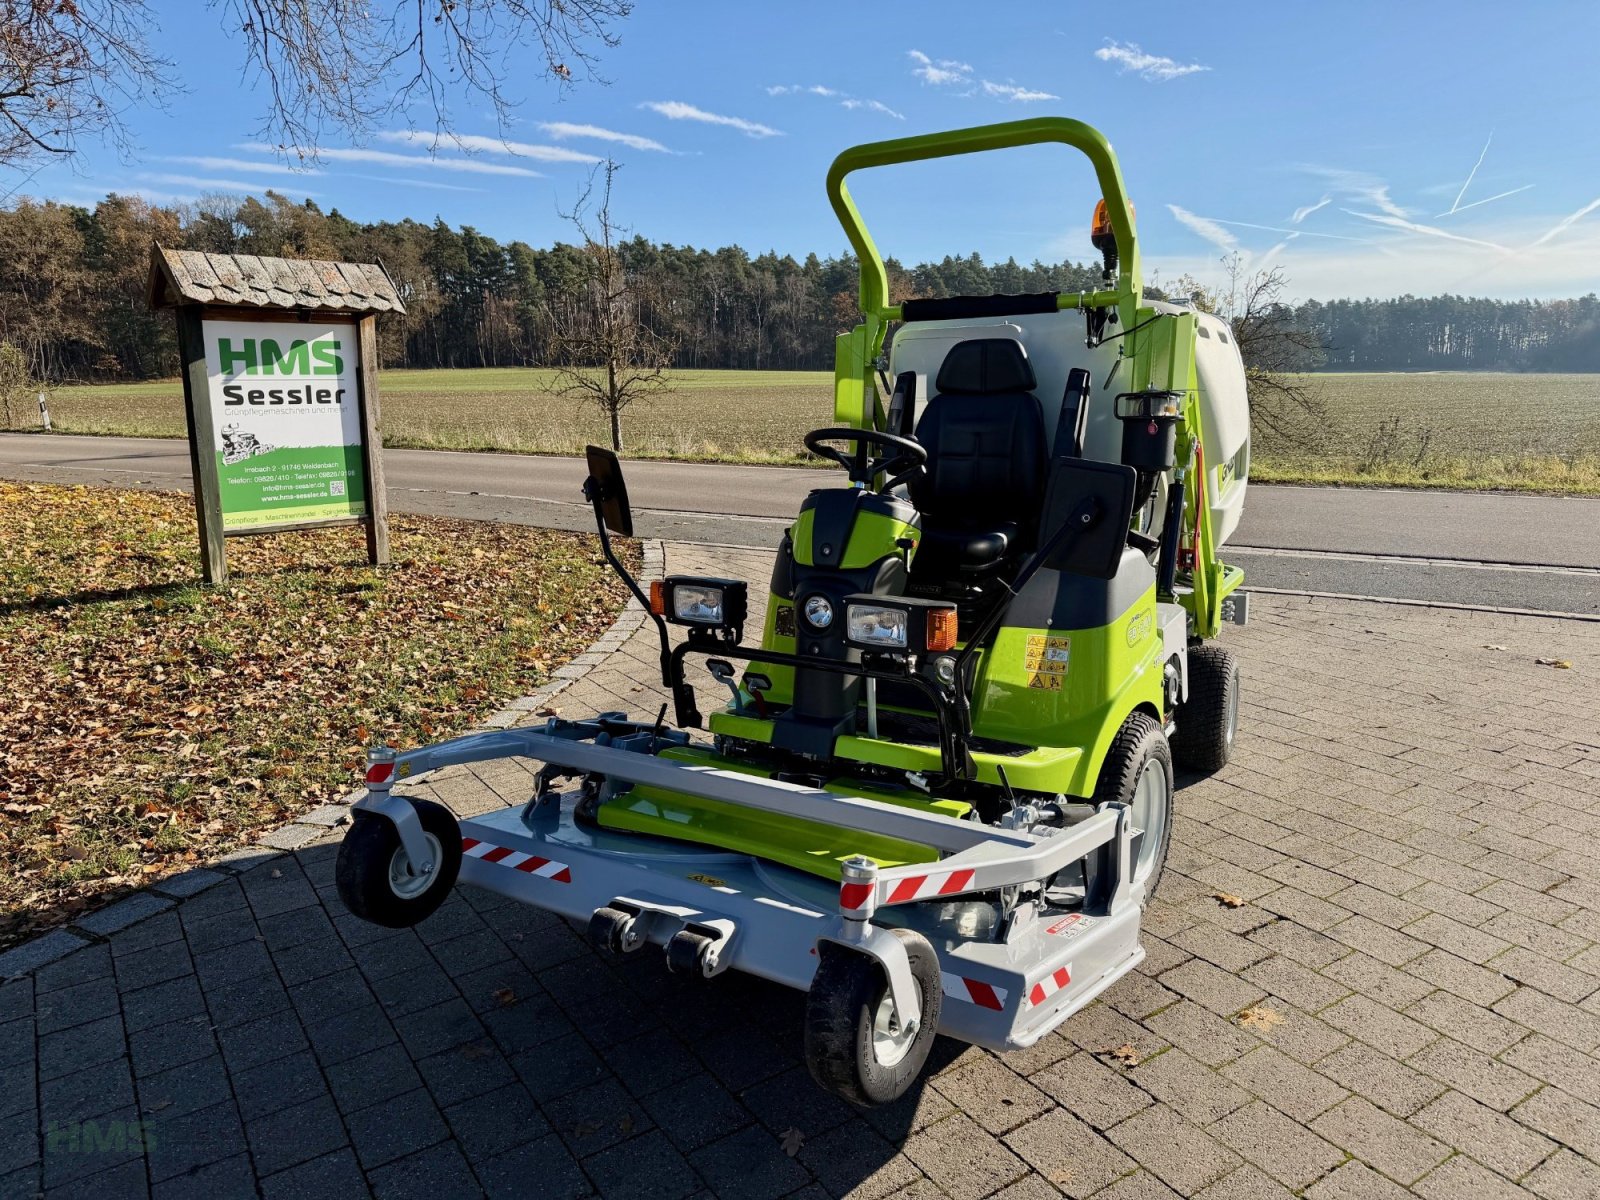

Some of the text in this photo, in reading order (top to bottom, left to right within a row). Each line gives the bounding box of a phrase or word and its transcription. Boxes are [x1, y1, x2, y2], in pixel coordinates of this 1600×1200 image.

[218, 338, 344, 375] HMS
[223, 385, 346, 406] Sessler
[311, 406, 326, 414] und
[261, 491, 328, 502] www.hms-sessler.de
